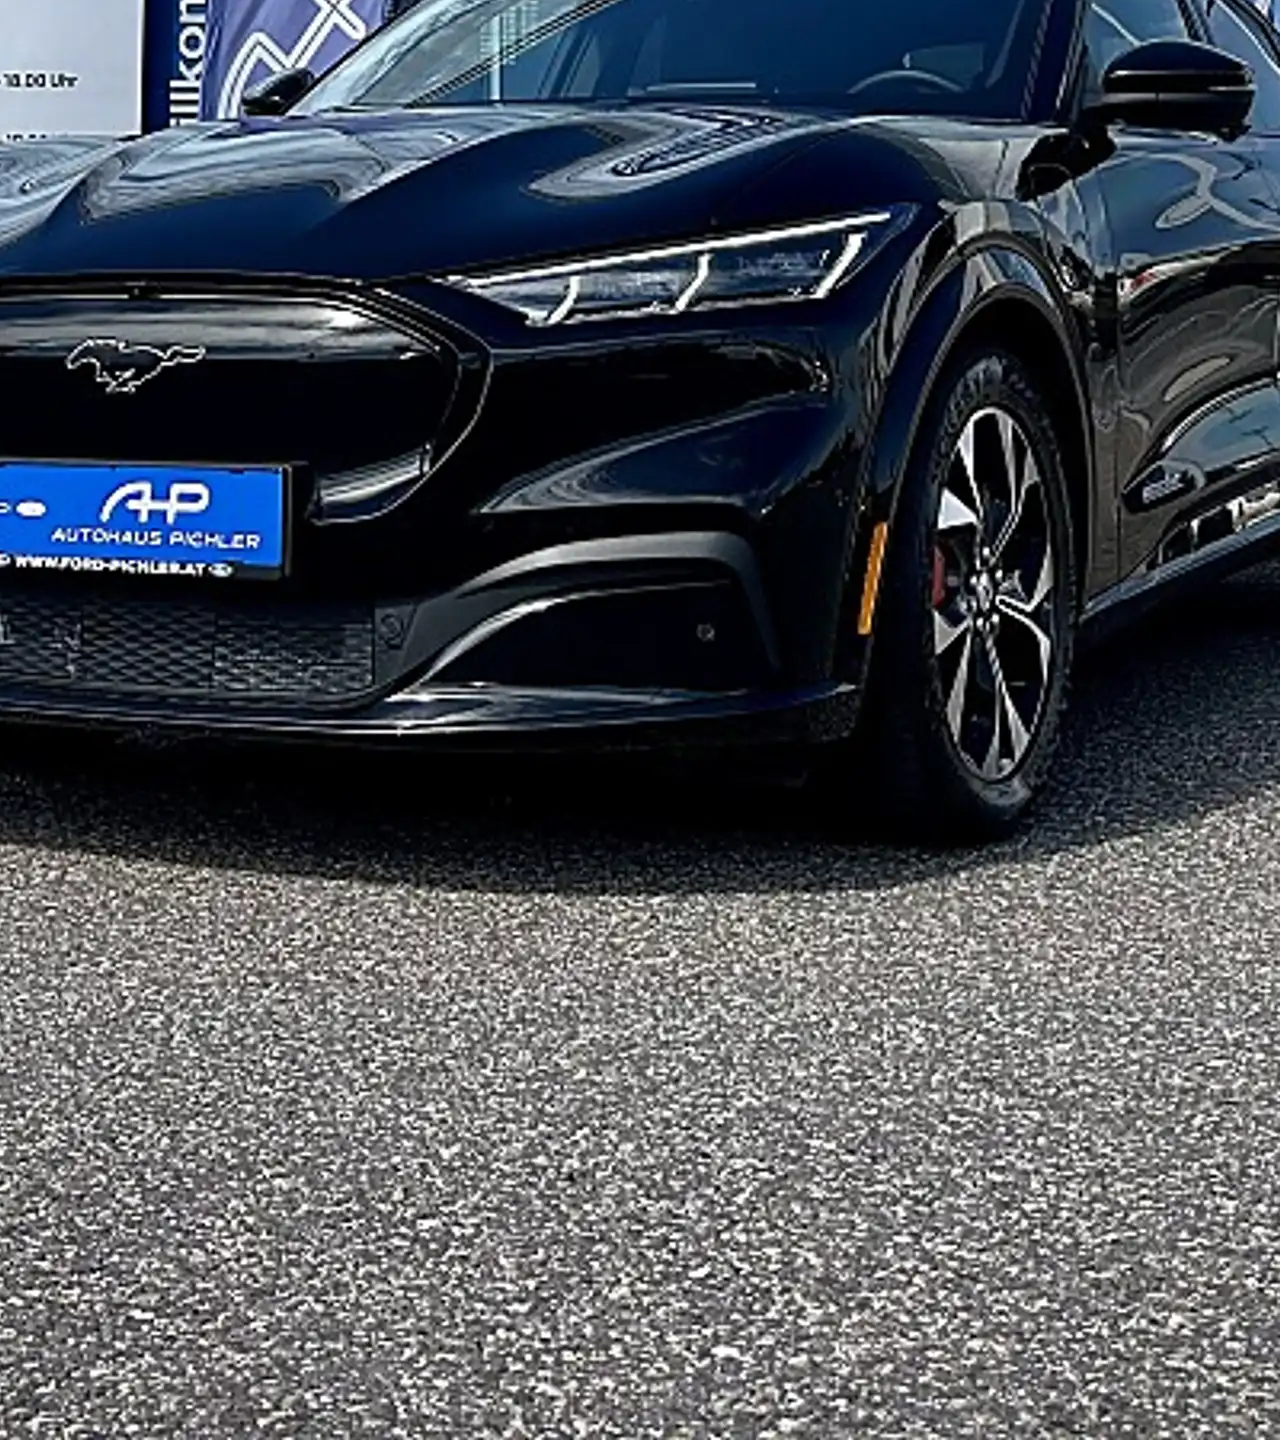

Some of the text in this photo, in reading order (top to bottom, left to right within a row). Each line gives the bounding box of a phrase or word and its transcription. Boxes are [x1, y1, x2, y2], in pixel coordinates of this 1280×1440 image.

[51, 74, 78, 88] Uhr
[50, 527, 261, 550] AUTOHAUS PICHLER
